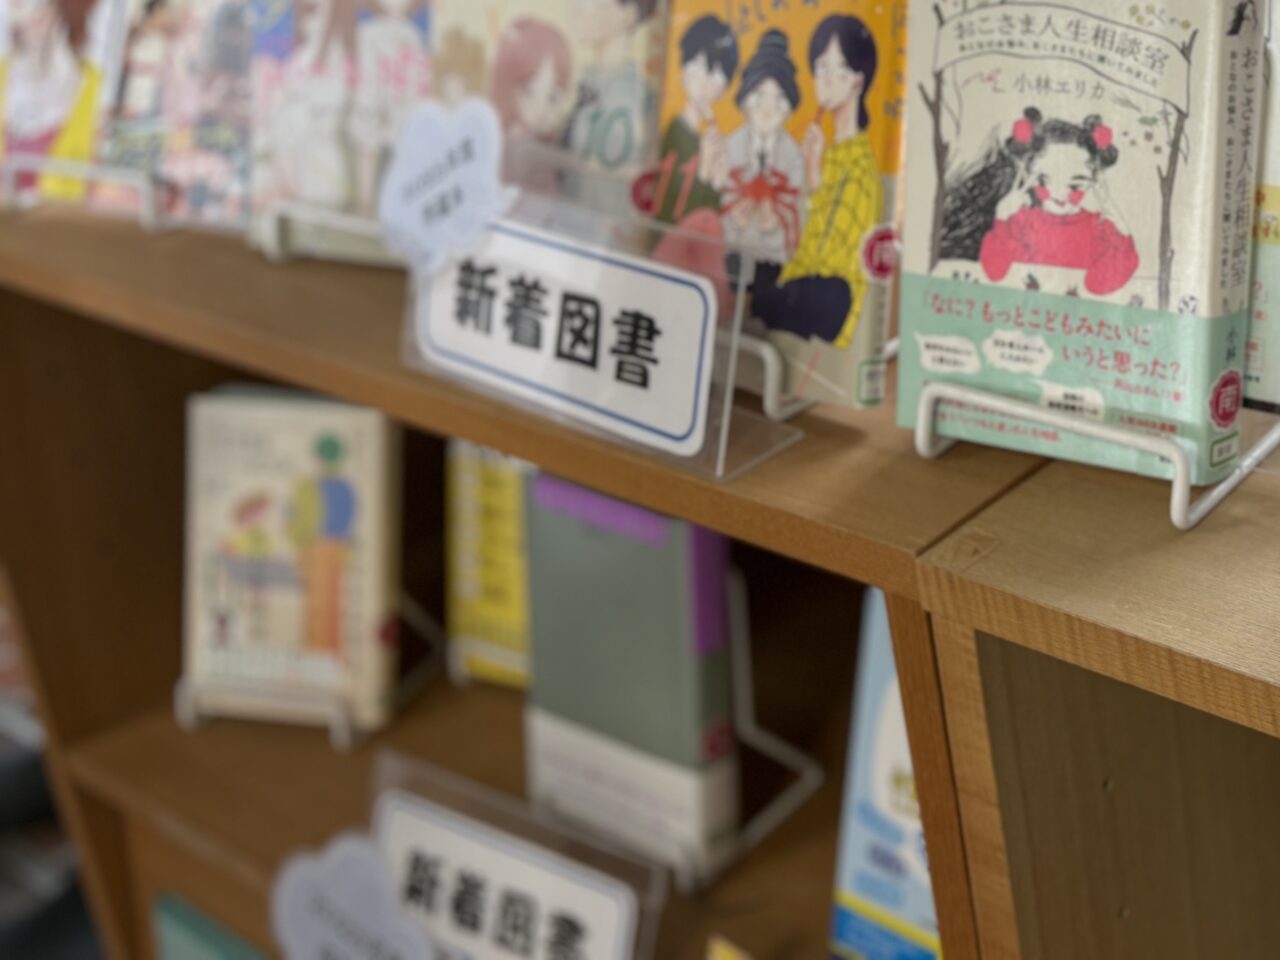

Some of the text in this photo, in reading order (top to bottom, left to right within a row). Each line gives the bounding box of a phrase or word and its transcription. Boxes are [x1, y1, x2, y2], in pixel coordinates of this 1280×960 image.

[954, 10, 1171, 75] おこさま人生相談室
[1014, 73, 1107, 101] 小林エリカ
[453, 256, 662, 390] 新着図書
